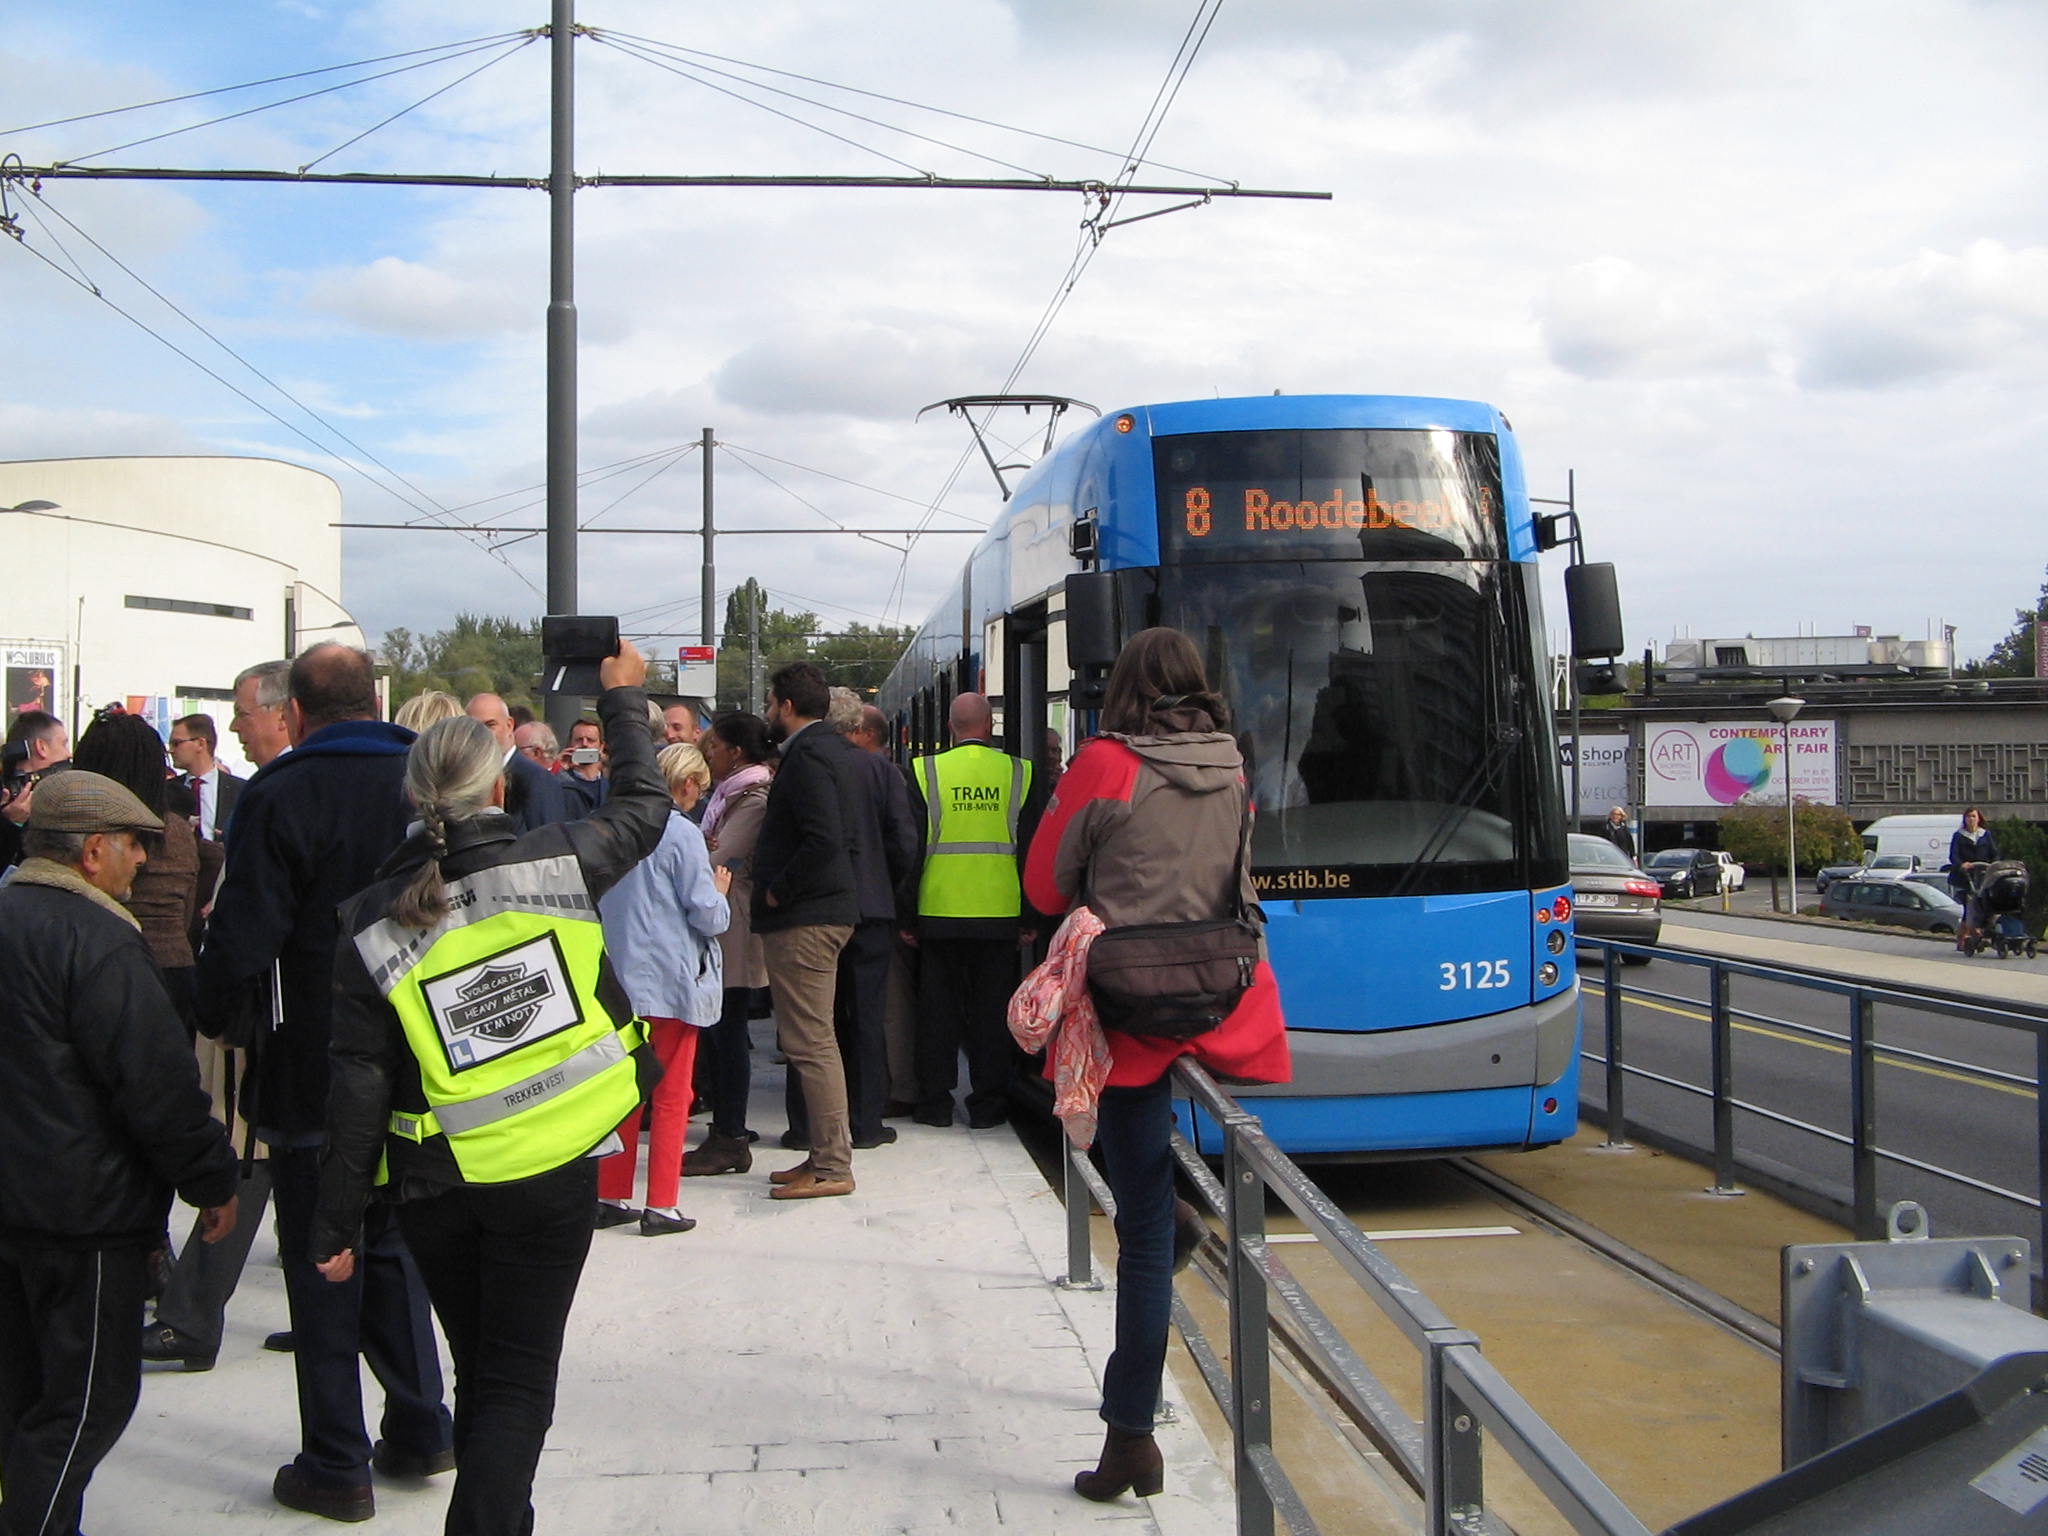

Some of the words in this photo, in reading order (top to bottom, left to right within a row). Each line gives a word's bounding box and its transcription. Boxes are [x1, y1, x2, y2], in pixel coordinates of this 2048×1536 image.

[1186, 487, 1211, 537] 8
[1709, 728, 1829, 739] CONTEMPORARY
[1656, 743, 1693, 760] ART
[1796, 743, 1829, 753] FAIR
[951, 787, 1000, 800] TRAM
[952, 803, 999, 811] STIB-MIVB
[467, 983, 491, 997] YOUR
[491, 976, 508, 989] CAR
[508, 971, 522, 983] IS
[1439, 960, 1510, 990] 3125
[464, 999, 498, 1020] HEAVY
[502, 985, 536, 1005] MÉTAL
[482, 1019, 506, 1034] I'M
[505, 1007, 531, 1025] NOT
[452, 1045, 473, 1066] L
[503, 1080, 544, 1108] TREKKER
[542, 1070, 566, 1090] VEST
